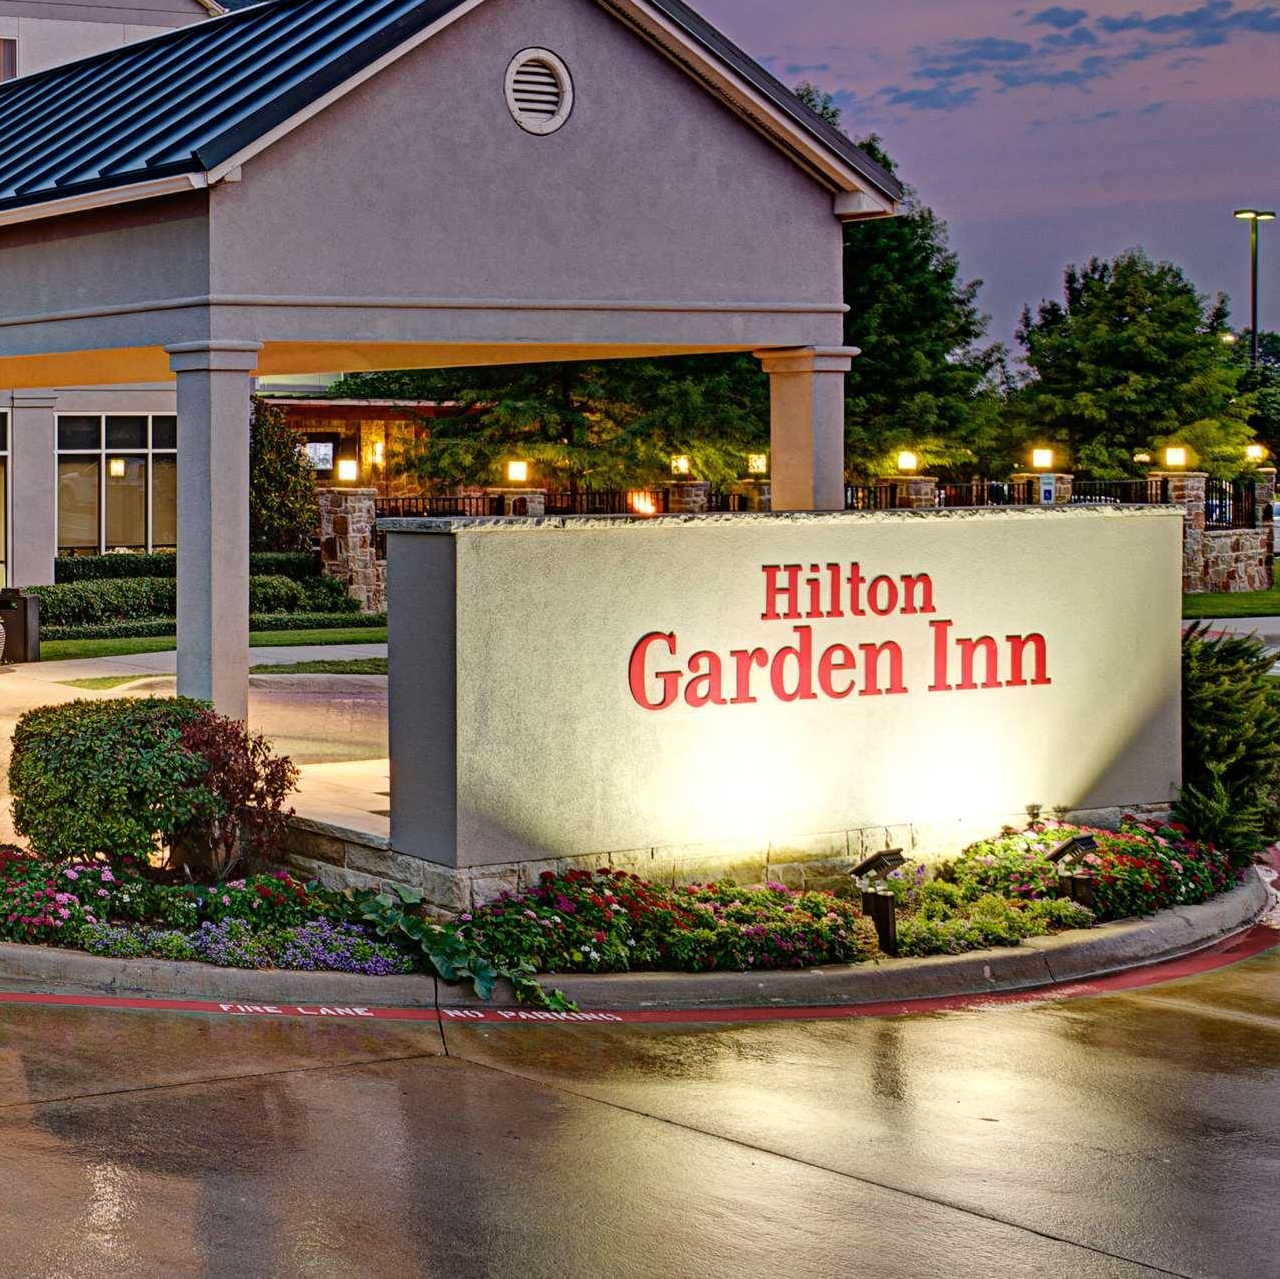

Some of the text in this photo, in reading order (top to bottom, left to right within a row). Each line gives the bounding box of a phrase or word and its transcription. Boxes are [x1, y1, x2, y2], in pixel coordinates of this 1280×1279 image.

[760, 561, 937, 621] Hilton
[627, 619, 1052, 711] Garden Inn
[218, 1003, 623, 1021] FIRE LANE NO PARKING
